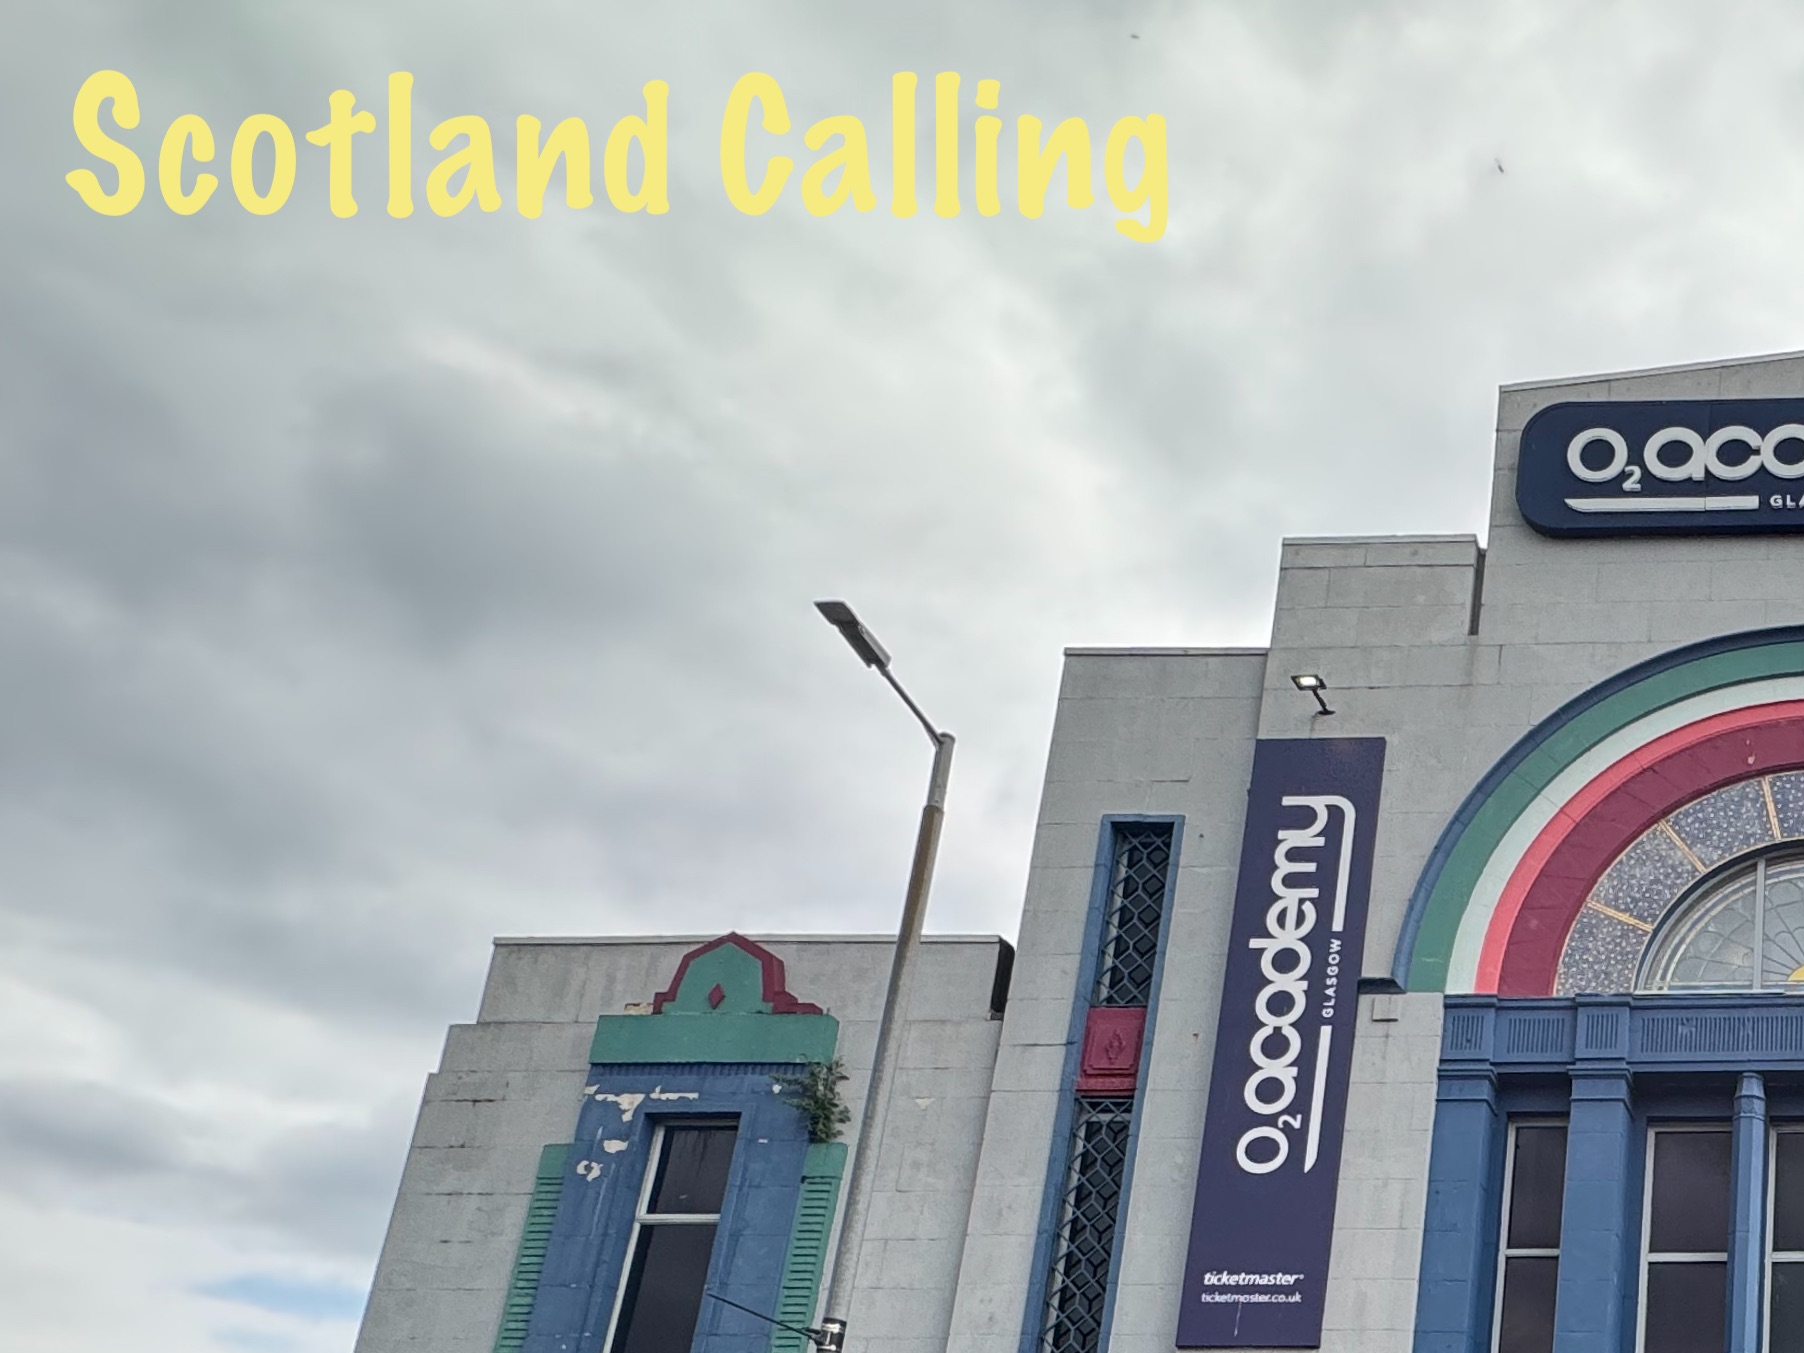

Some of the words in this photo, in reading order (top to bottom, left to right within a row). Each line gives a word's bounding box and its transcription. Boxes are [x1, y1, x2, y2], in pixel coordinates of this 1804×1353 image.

[1322, 937, 1342, 1018] GLASGOW
[1203, 1270, 1299, 1286] ticketmaster
[1201, 1291, 1302, 1303] ticketmaster.co.uk
